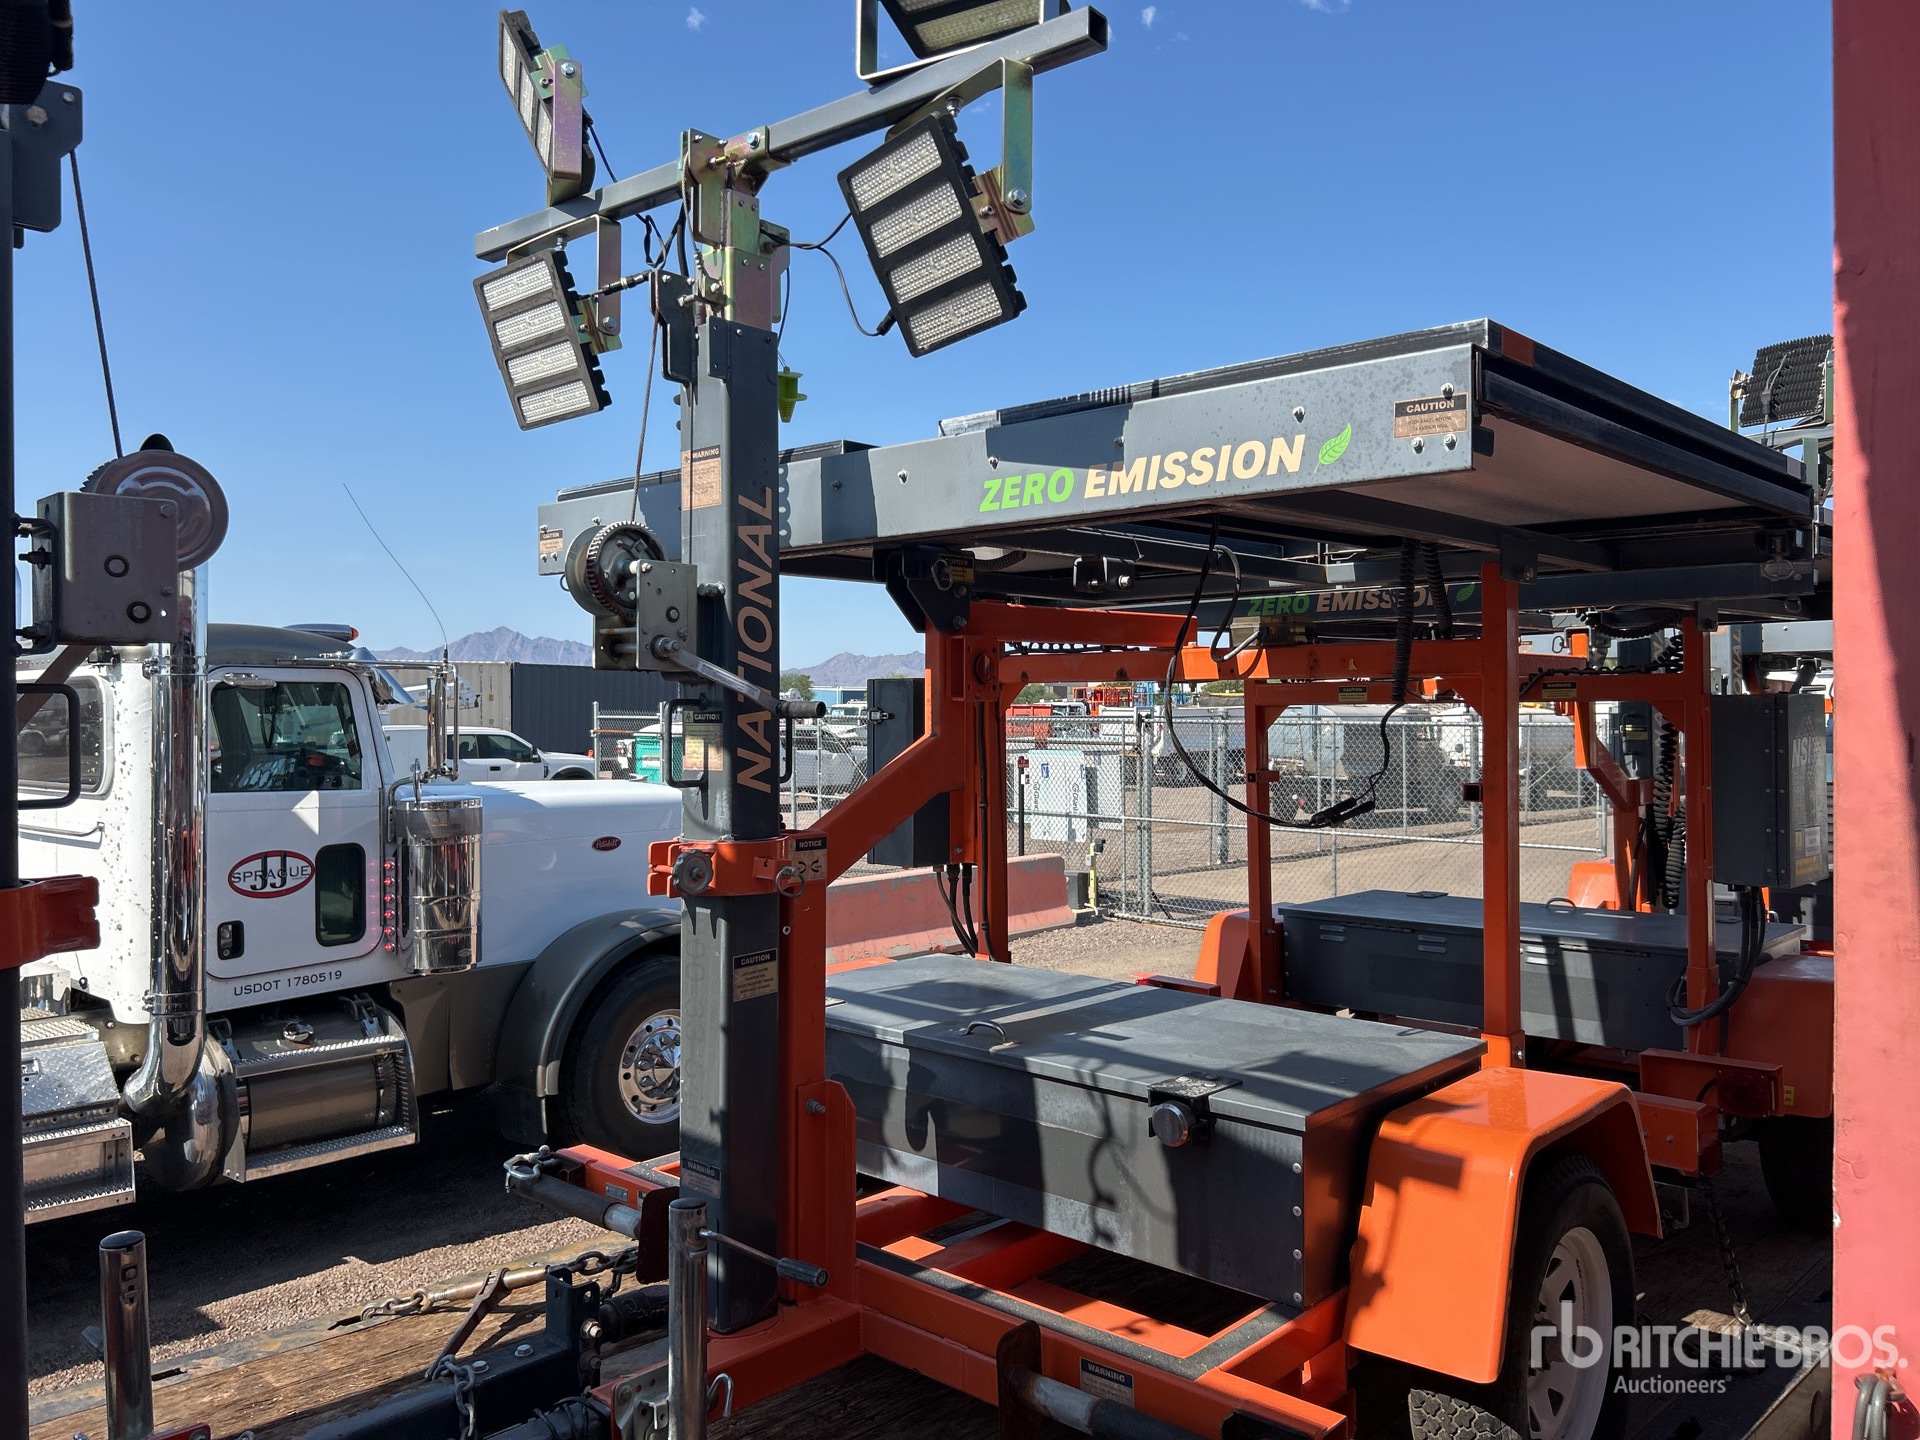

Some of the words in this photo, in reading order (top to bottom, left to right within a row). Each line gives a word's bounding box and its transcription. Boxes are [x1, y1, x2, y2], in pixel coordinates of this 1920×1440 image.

[1406, 399, 1455, 413] CAUTION
[692, 447, 720, 458] WARNING
[979, 467, 1075, 513] ZERO
[1083, 433, 1306, 498] EMISSION
[1248, 594, 1310, 617] ZERO
[1316, 584, 1449, 613] EMISSO
[736, 486, 773, 794] NATIONAL
[694, 713, 721, 721] CAUTION
[799, 840, 822, 848] NOTICE
[232, 865, 310, 884] SPRAGUE
[740, 954, 770, 966] CAUTION
[233, 979, 282, 997] USDOT
[287, 969, 343, 988] 1780519
[687, 1160, 715, 1177] WARNING
[1087, 1362, 1126, 1383] WARNING
